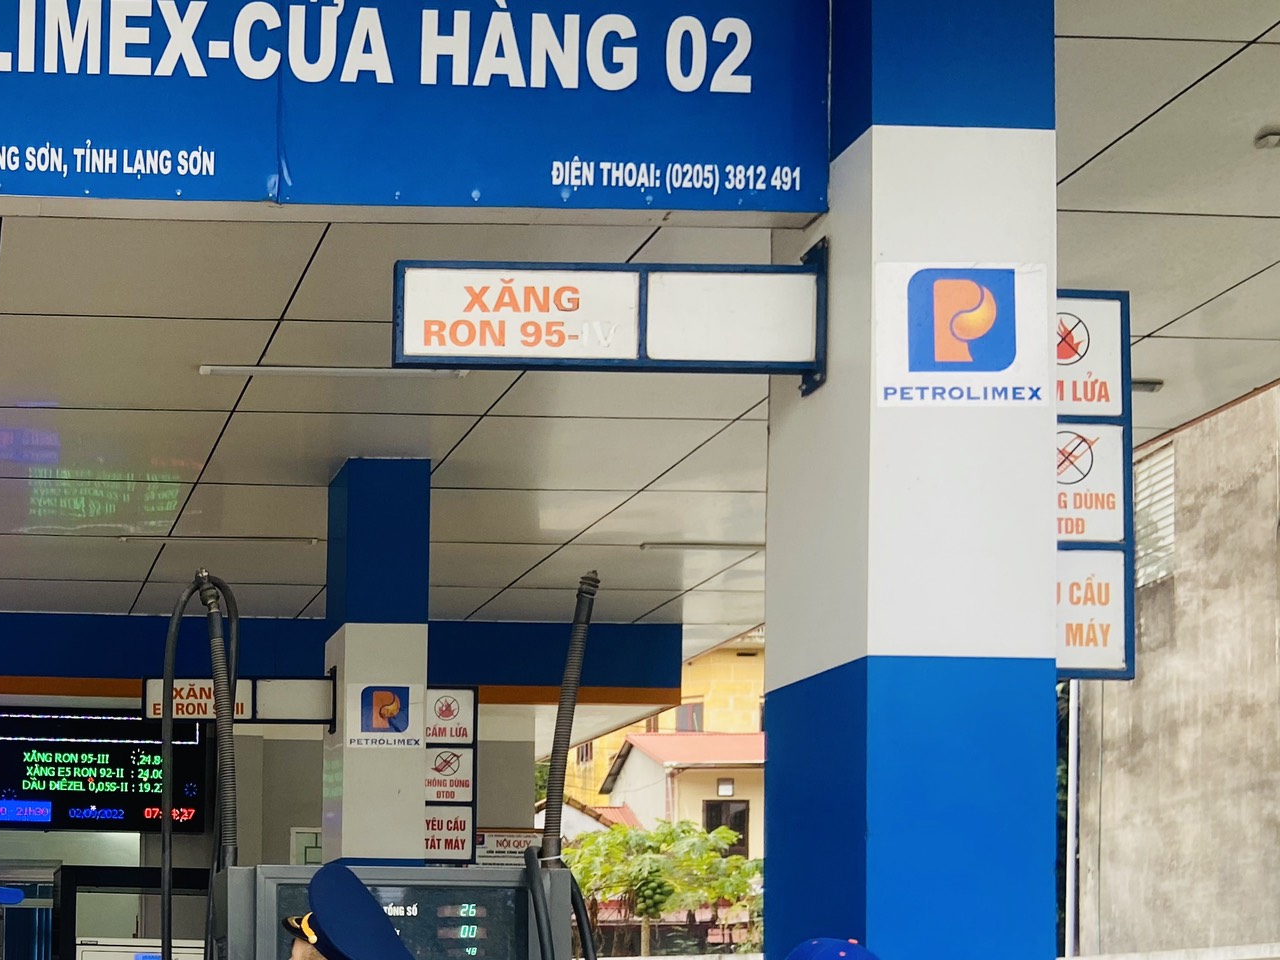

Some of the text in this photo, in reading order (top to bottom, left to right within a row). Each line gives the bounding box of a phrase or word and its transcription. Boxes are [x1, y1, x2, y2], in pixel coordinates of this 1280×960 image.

[420, 0, 638, 91] HÀNG
[665, 15, 752, 93] 02
[24, 142, 68, 178] SƠN,
[73, 139, 118, 174] TỈNH
[122, 149, 172, 180] LẠNG
[177, 146, 216, 176] SƠN
[551, 155, 801, 195] ĐIỆN THOẠI: (0205) 3812 491
[462, 278, 581, 313] XĂNG
[423, 319, 506, 347] RON
[882, 385, 1043, 402] PETROLIMEX
[1071, 371, 1110, 402] LỬA
[1073, 489, 1116, 510] DÙNG
[1057, 517, 1085, 534] TDĐ
[1069, 573, 1110, 606] CẦU
[1065, 618, 1111, 647] MÁY
[173, 683, 216, 700] XĂN
[175, 703, 208, 715] RON
[425, 722, 468, 738] CẤM LỬA
[349, 737, 420, 746] PETROLIMEX
[23, 750, 163, 766] XĂNG RON 95-III 24.8
[26, 764, 56, 777] XĂNG
[57, 767, 71, 777] E5
[73, 767, 98, 778] RON
[99, 768, 124, 778] 92-II
[22, 777, 46, 790] DẦU
[88, 782, 129, 793] 0,05S-II
[450, 777, 470, 788] DÙNG
[425, 817, 443, 831] YÊU
[425, 834, 466, 851] TẮT MÁY
[496, 838, 511, 849] NỘI
[406, 903, 418, 916] SỐ
[460, 903, 477, 917] 26
[460, 925, 477, 938] 00
[465, 947, 477, 956] 48
